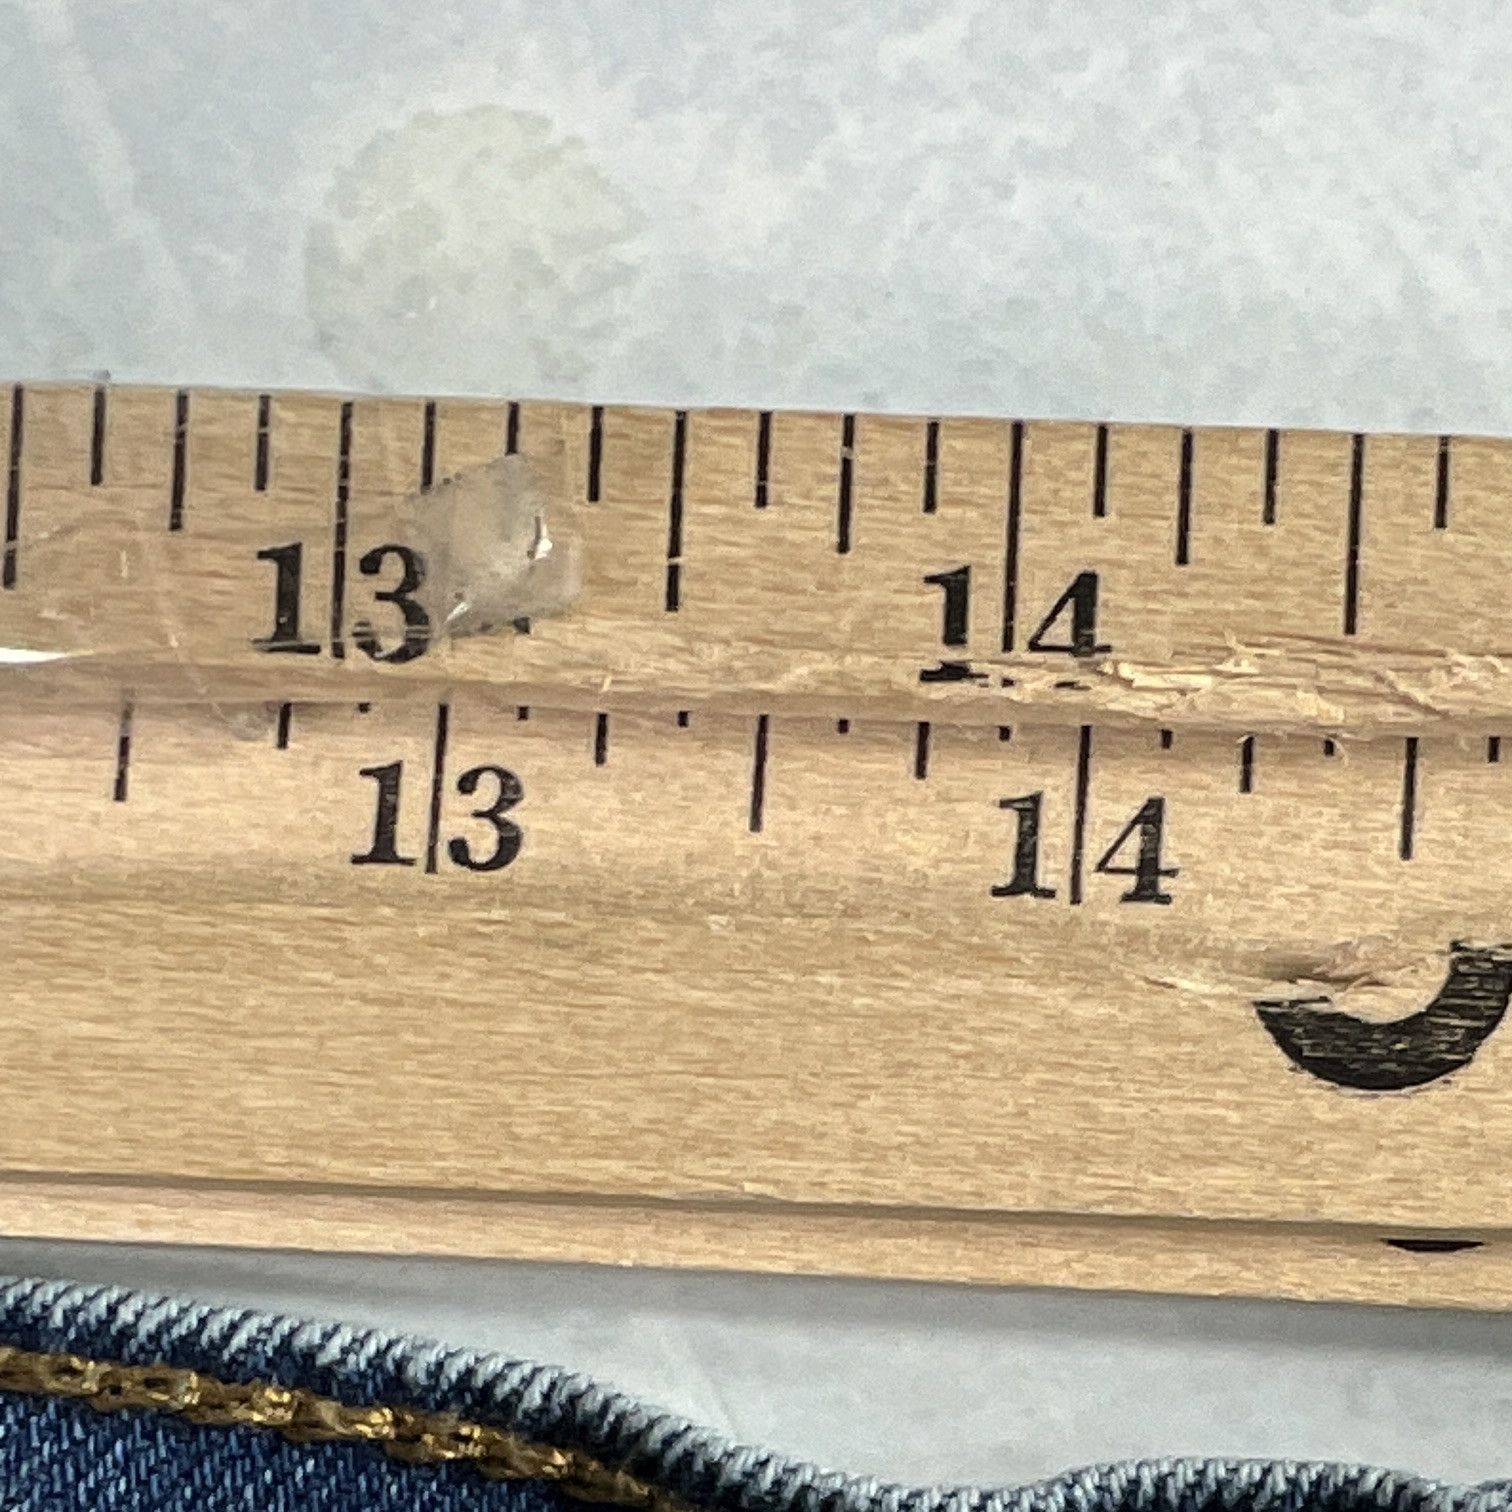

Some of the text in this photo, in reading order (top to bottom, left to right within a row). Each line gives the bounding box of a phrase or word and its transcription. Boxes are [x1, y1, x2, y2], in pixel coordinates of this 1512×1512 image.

[252, 542, 432, 664] 13
[919, 564, 1113, 689] 14
[349, 759, 527, 874] 13
[990, 789, 1181, 905] 14
